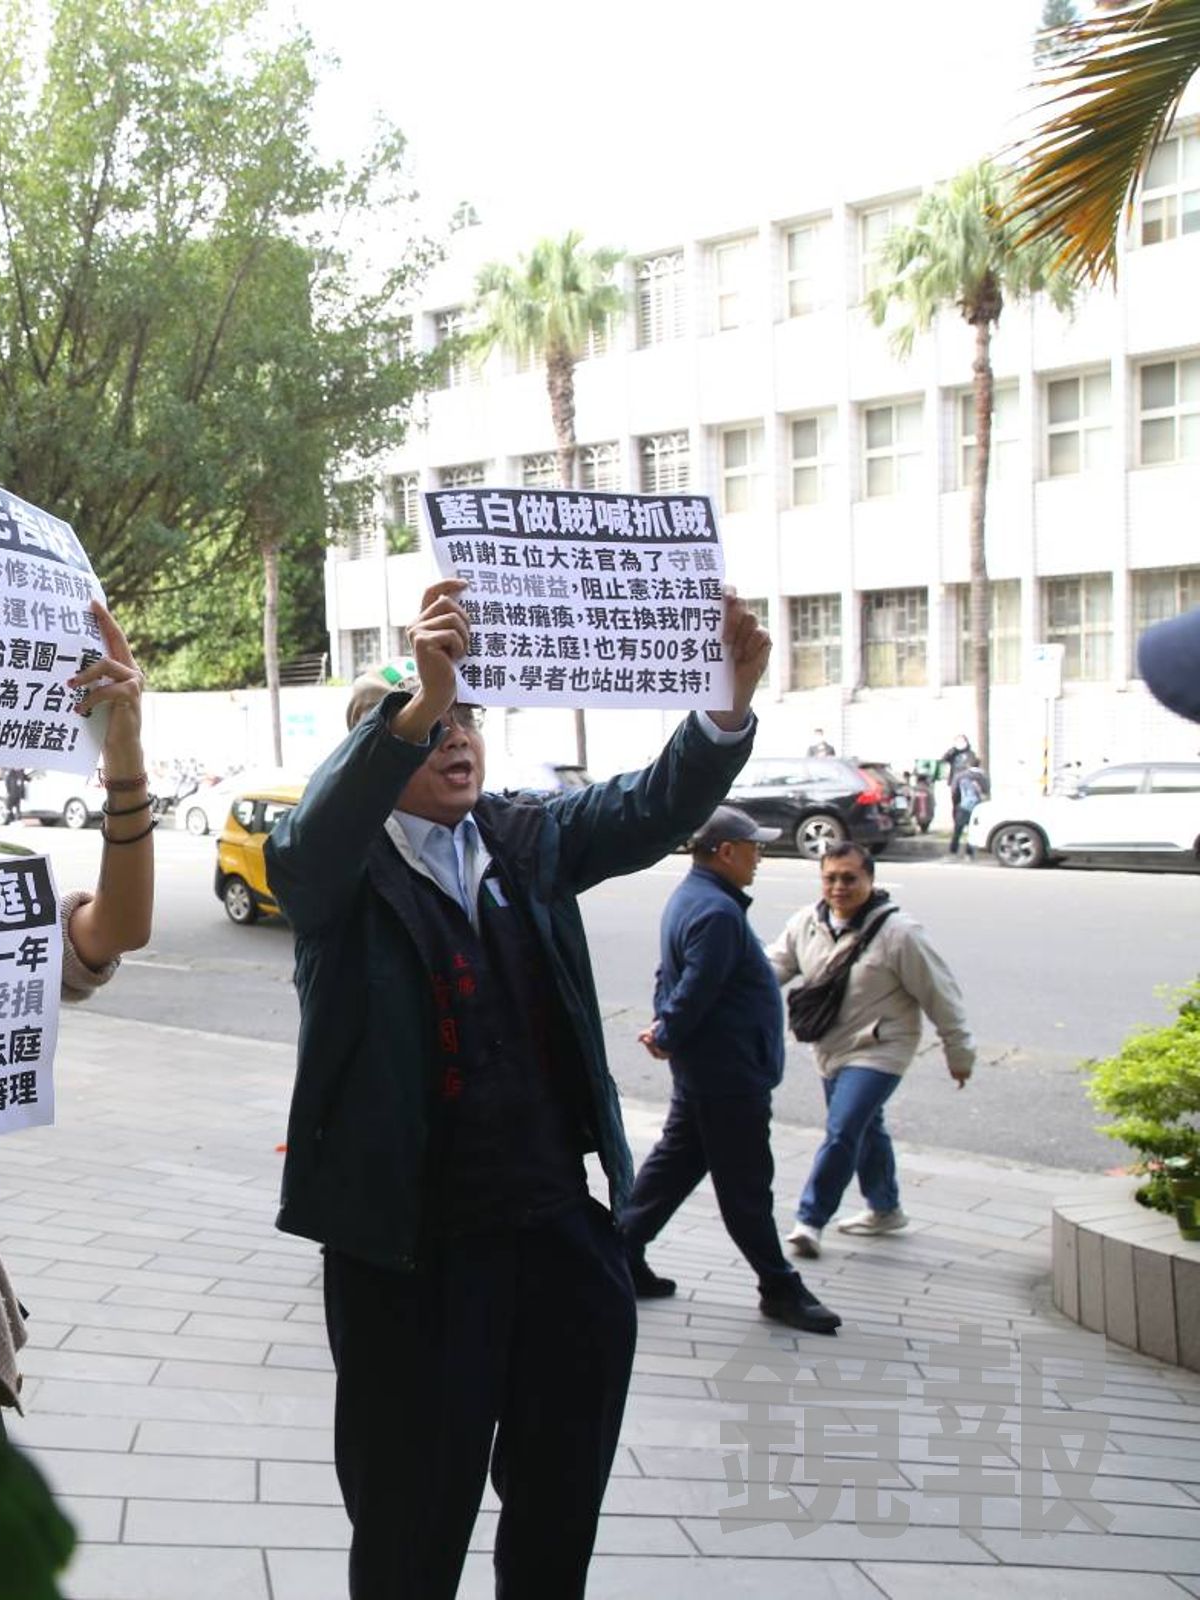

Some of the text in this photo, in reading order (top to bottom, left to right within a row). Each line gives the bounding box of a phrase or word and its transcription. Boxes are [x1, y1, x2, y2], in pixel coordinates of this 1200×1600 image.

[435, 493, 711, 538] 藍白做賊喊抓賊
